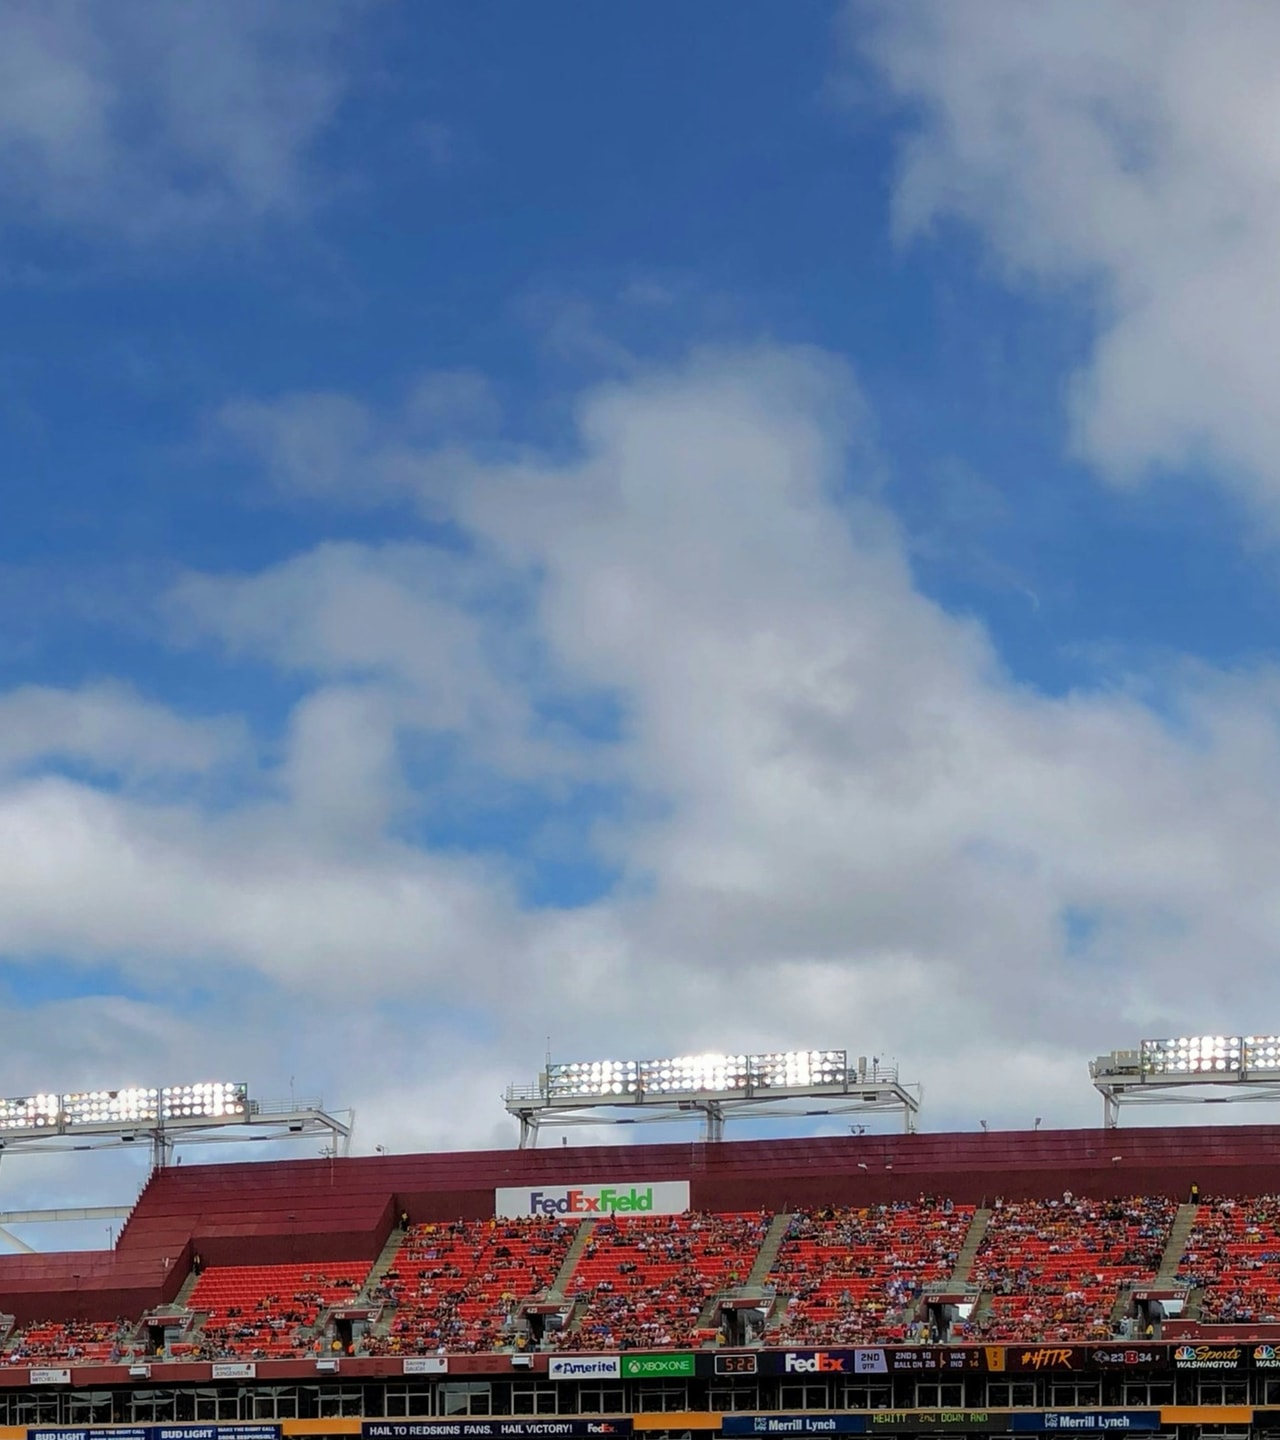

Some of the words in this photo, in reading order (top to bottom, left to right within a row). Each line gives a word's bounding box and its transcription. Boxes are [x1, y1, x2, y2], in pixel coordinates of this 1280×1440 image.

[531, 1188, 652, 1214] FedExField
[860, 1353, 880, 1362] 2ND
[950, 1352, 966, 1360] WAS
[1110, 1353, 1124, 1362] 23
[1138, 1353, 1152, 1362] 34
[1195, 1345, 1241, 1361] Sports
[785, 1353, 844, 1372] FedEx
[768, 1419, 802, 1430] Merrill
[806, 1419, 836, 1432] Lynch
[1059, 1416, 1095, 1428] Merrill
[1098, 1416, 1130, 1429] Lynch
[35, 1433, 56, 1440] BUD
[57, 1432, 86, 1440] LIGHT
[161, 1430, 182, 1439] BUD
[184, 1429, 213, 1438] LIGHT
[369, 1426, 392, 1436] HAIL
[393, 1426, 407, 1435] TO
[409, 1425, 460, 1435] REDSKINS
[463, 1425, 493, 1434] FANS.
[500, 1424, 524, 1434] HAIL
[526, 1424, 573, 1433] VICTORY!
[587, 1423, 615, 1433] FedEx
